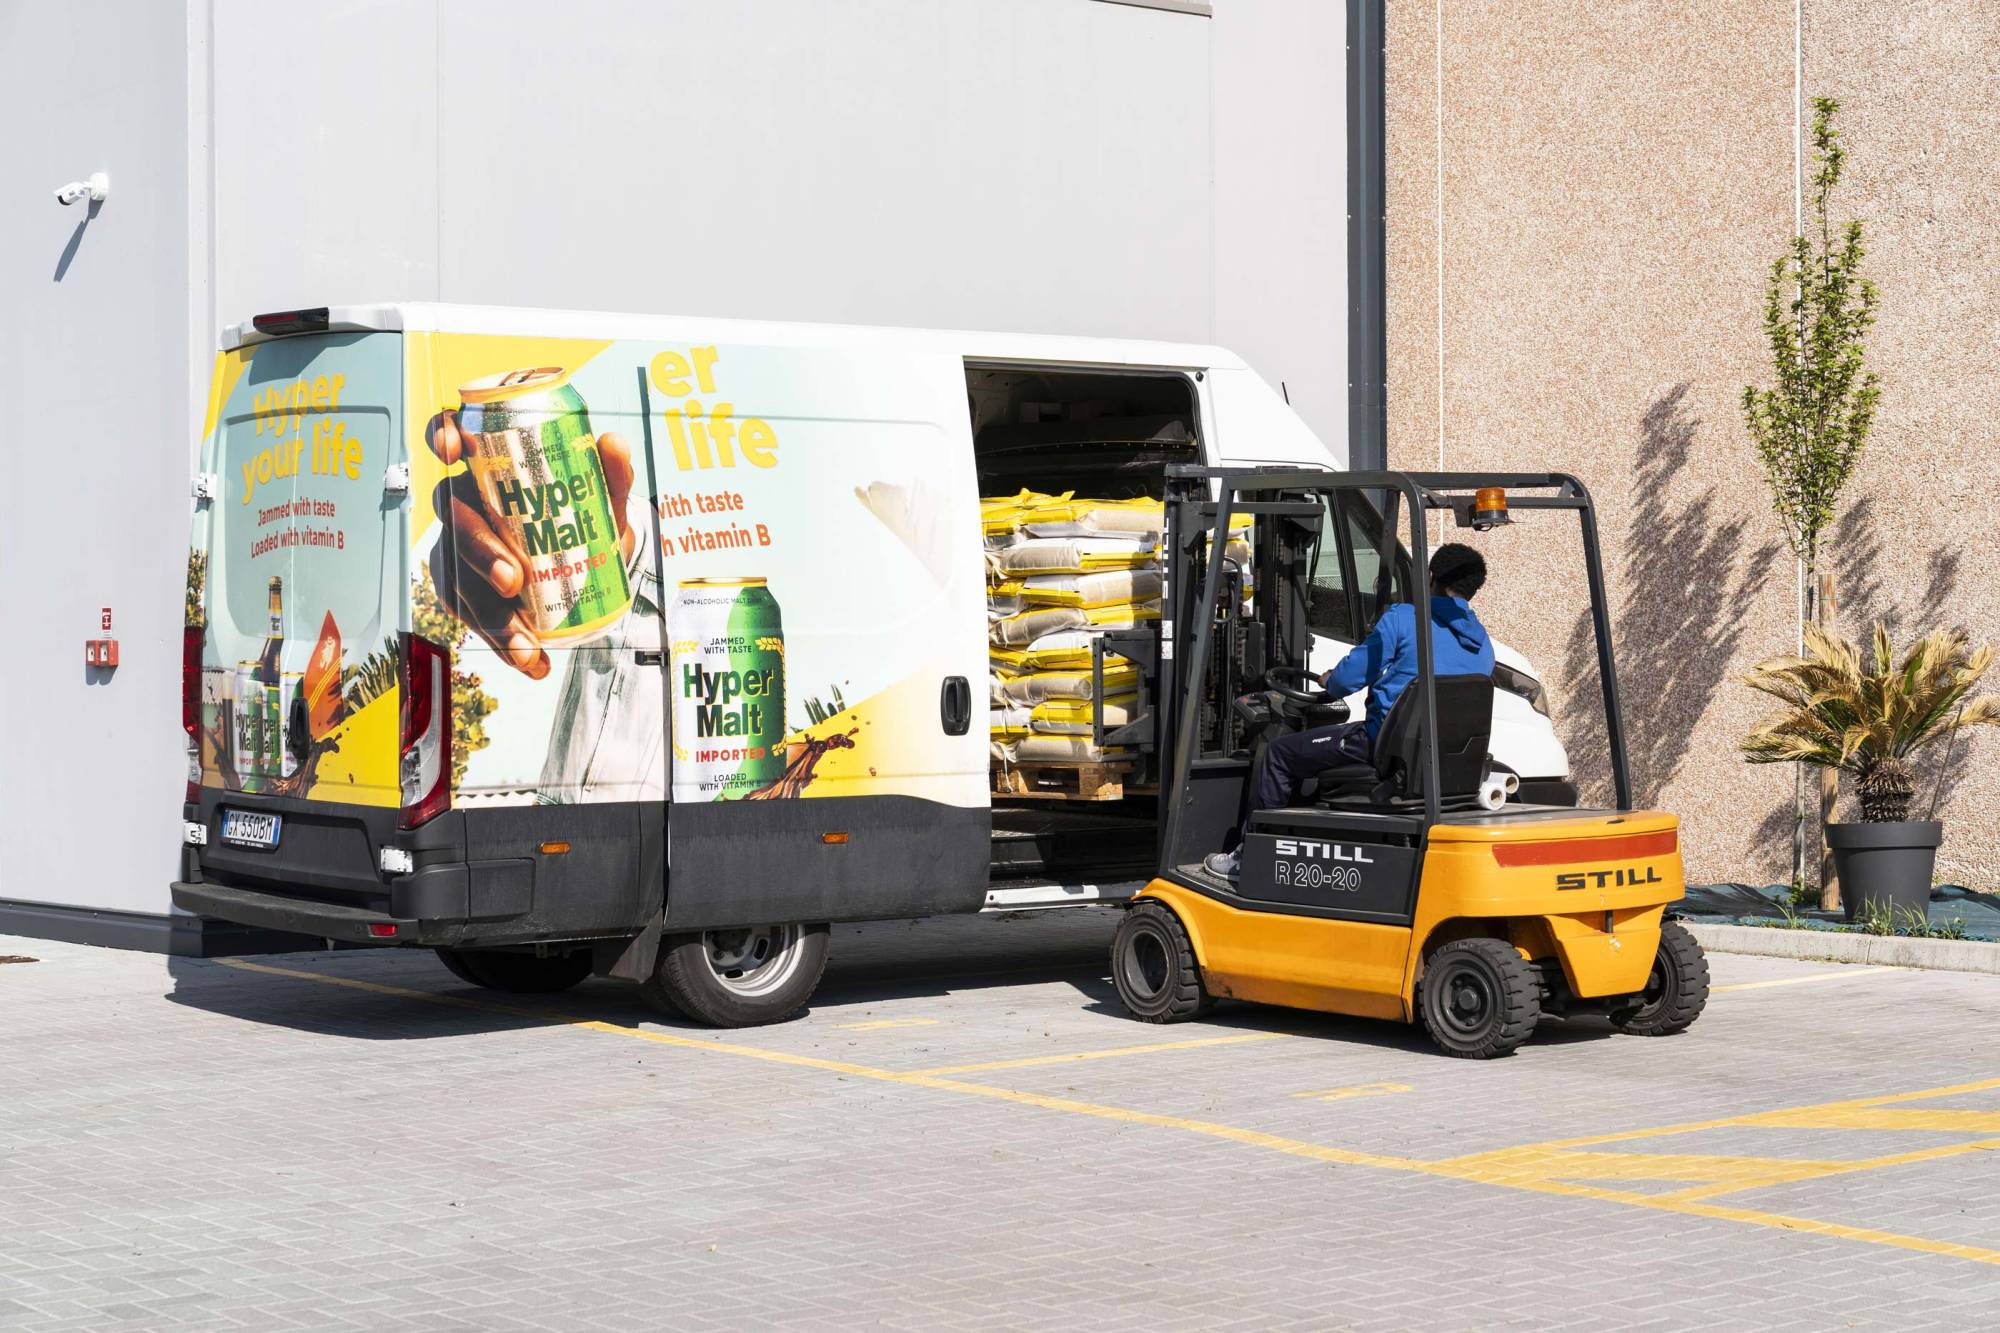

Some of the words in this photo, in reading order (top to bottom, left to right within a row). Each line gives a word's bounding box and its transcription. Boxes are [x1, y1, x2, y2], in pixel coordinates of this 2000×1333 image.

[253, 373, 345, 436] Hyper
[664, 399, 779, 471] life
[242, 438, 304, 505] your
[312, 416, 362, 481] life
[496, 468, 595, 521] Hyper
[696, 490, 745, 514] taste
[258, 498, 290, 527] Jammed
[292, 496, 311, 516] with
[313, 499, 336, 517] taste
[251, 530, 279, 559] Loaded
[281, 526, 299, 548] with
[301, 525, 335, 548] vitamin
[337, 530, 344, 550] B
[523, 510, 599, 557] Malt
[678, 522, 752, 553] vitamin
[755, 523, 771, 546] B
[532, 551, 607, 583] IMPORTED
[704, 646, 725, 654] WITH
[727, 645, 752, 654] TASTE
[710, 637, 745, 646] JAMMED
[683, 663, 774, 705] Hyper
[696, 703, 762, 738] Malt
[696, 747, 766, 763] IMPORTED
[700, 782, 719, 791] WITH
[721, 781, 755, 790] VITAMIN
[714, 773, 747, 782] LOADED
[228, 813, 240, 837] GX
[241, 814, 274, 841] 550BM
[1276, 840, 1374, 863] STILL
[1275, 860, 1290, 885] R
[1294, 863, 1361, 891] 20-20
[1556, 867, 1662, 891] STILL
